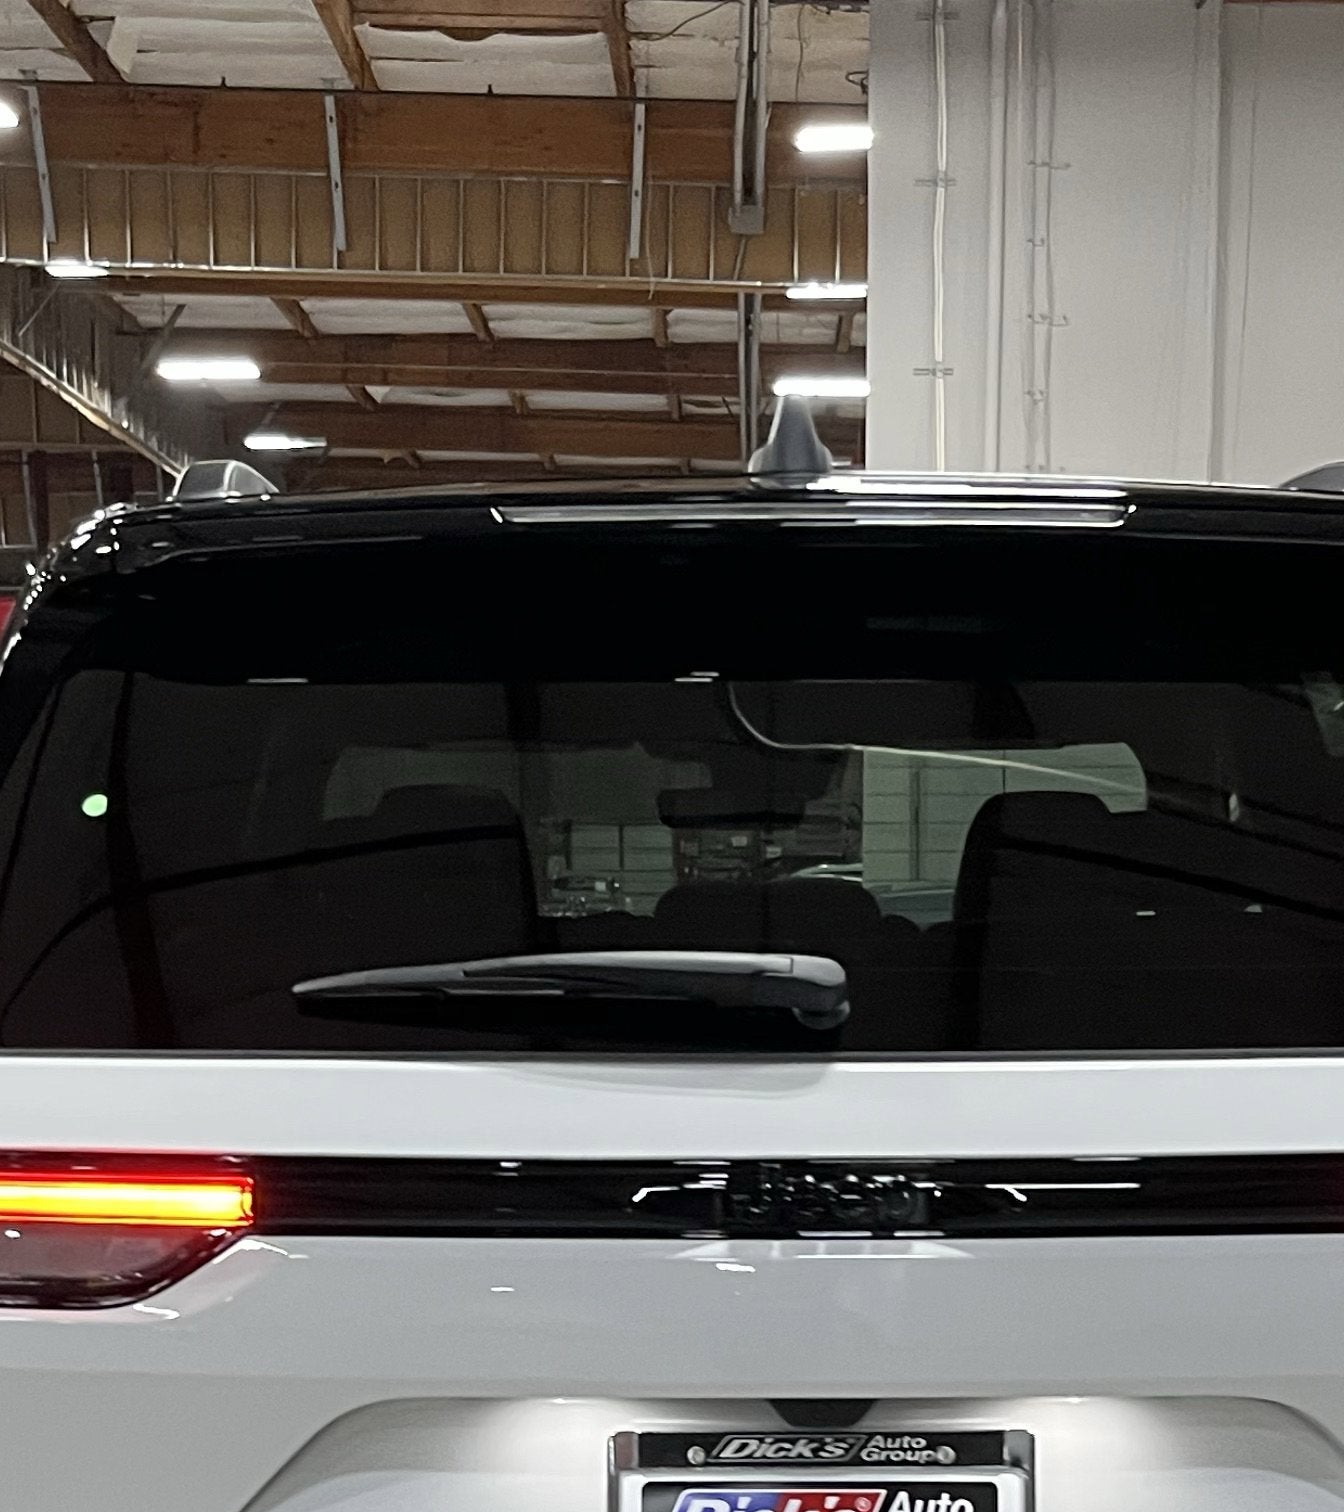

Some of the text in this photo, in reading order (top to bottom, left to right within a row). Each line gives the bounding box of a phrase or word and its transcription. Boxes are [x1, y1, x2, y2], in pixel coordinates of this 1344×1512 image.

[719, 1438, 850, 1459] Dick's
[867, 1435, 928, 1449] Auto
[860, 1448, 938, 1464] Group
